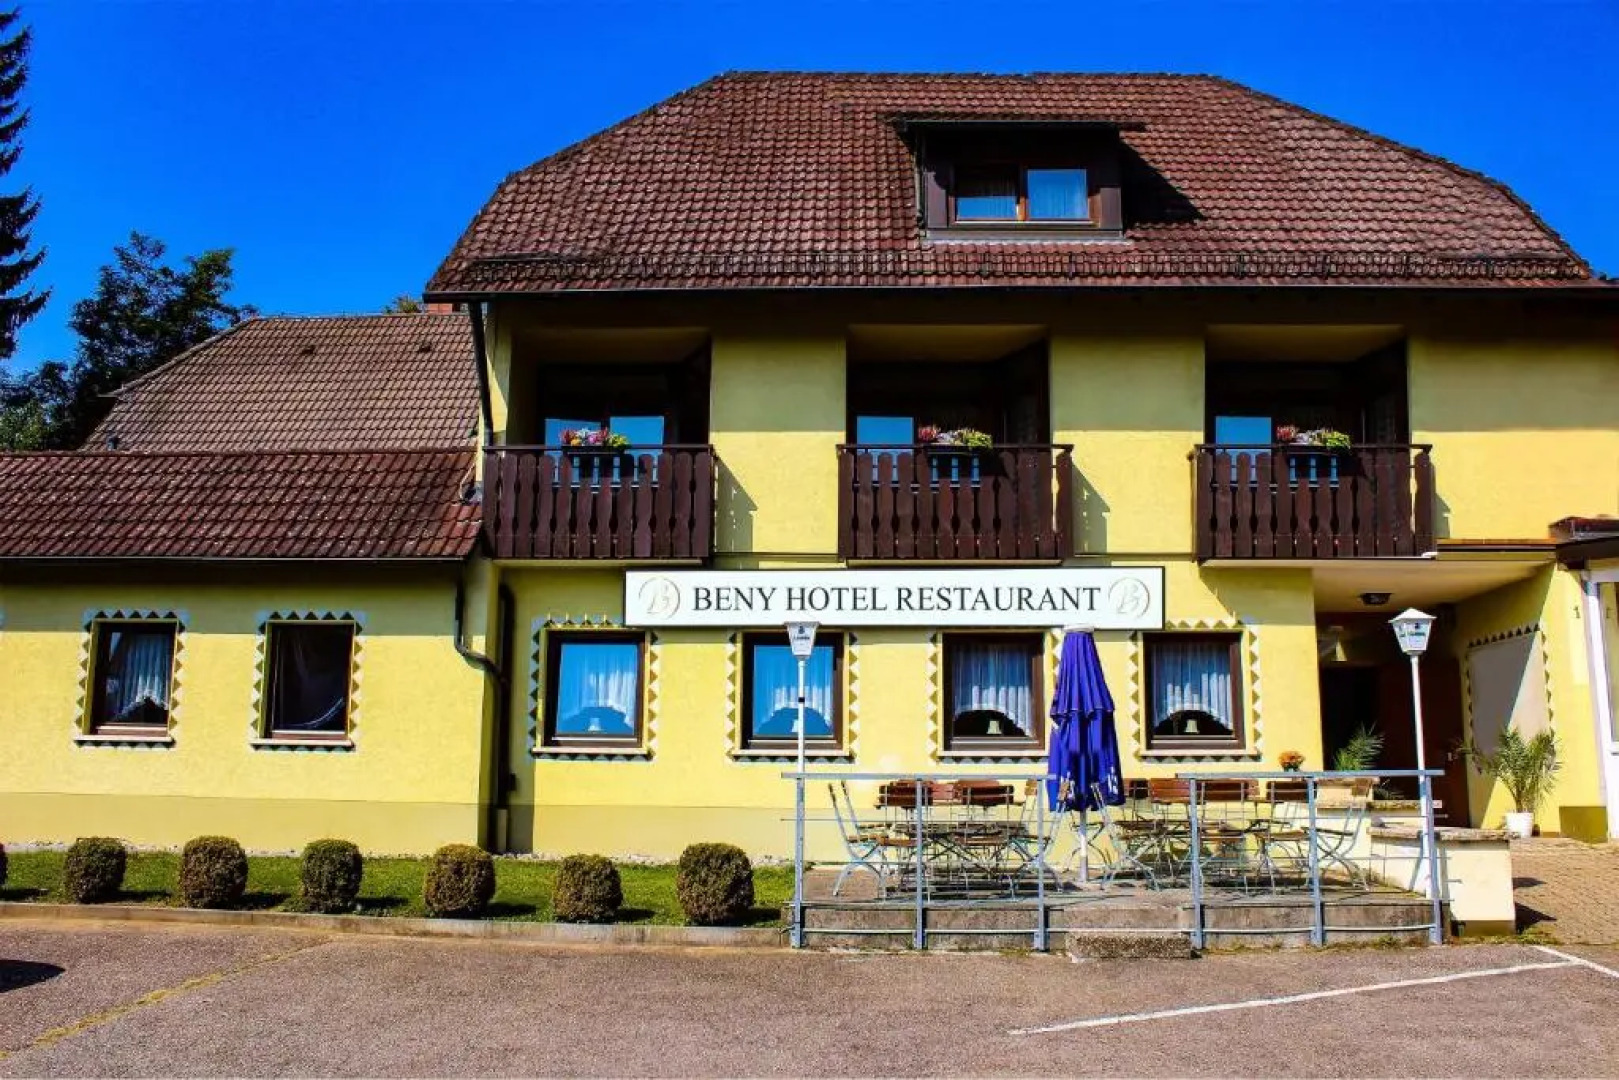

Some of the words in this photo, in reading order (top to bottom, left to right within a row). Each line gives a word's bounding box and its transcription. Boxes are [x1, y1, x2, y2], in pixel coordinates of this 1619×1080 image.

[693, 586, 777, 611] BENY
[786, 586, 888, 611] HOTEL
[895, 586, 1101, 611] RESTAURANT
